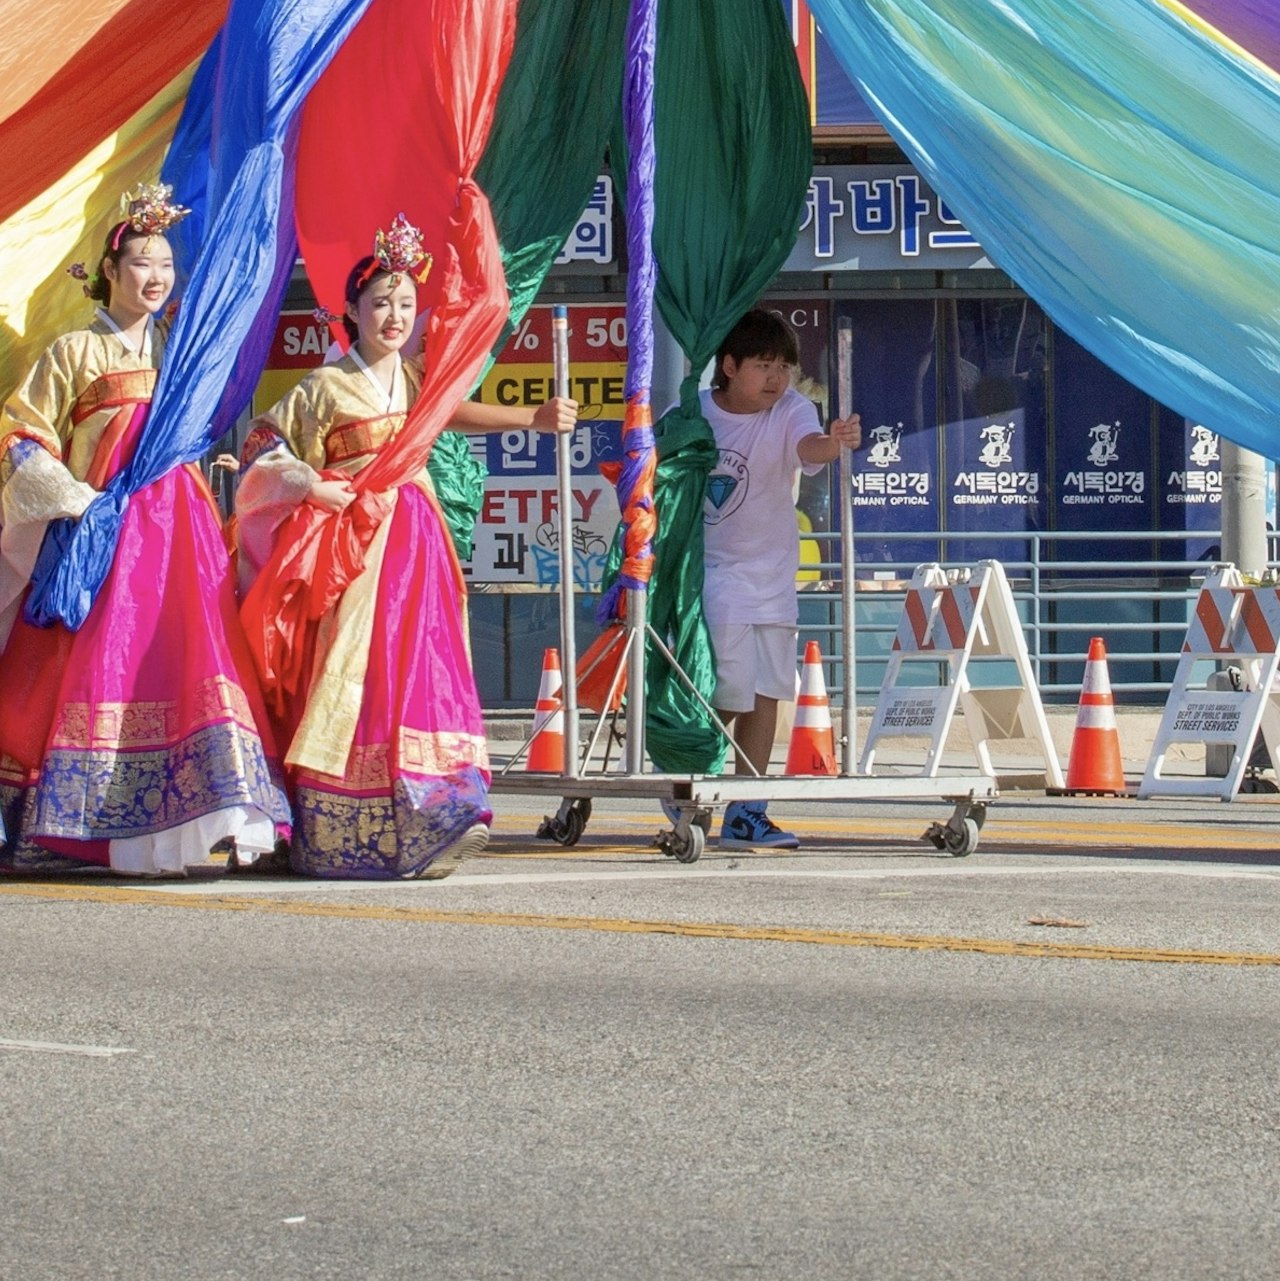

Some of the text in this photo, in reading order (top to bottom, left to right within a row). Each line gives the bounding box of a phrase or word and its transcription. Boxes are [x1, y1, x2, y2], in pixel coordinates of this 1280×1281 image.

[283, 325, 331, 356] SAL
[954, 472, 1040, 495] 서독안경
[1063, 471, 1145, 494] 서독안경
[890, 496, 930, 506] OPTICAL
[953, 495, 1040, 505] GERMANY OPTICAL
[1062, 494, 1145, 505] GERMANY OPTICAL
[1166, 494, 1206, 504] GERMANY
[1173, 721, 1239, 732] STREET SERVICES
